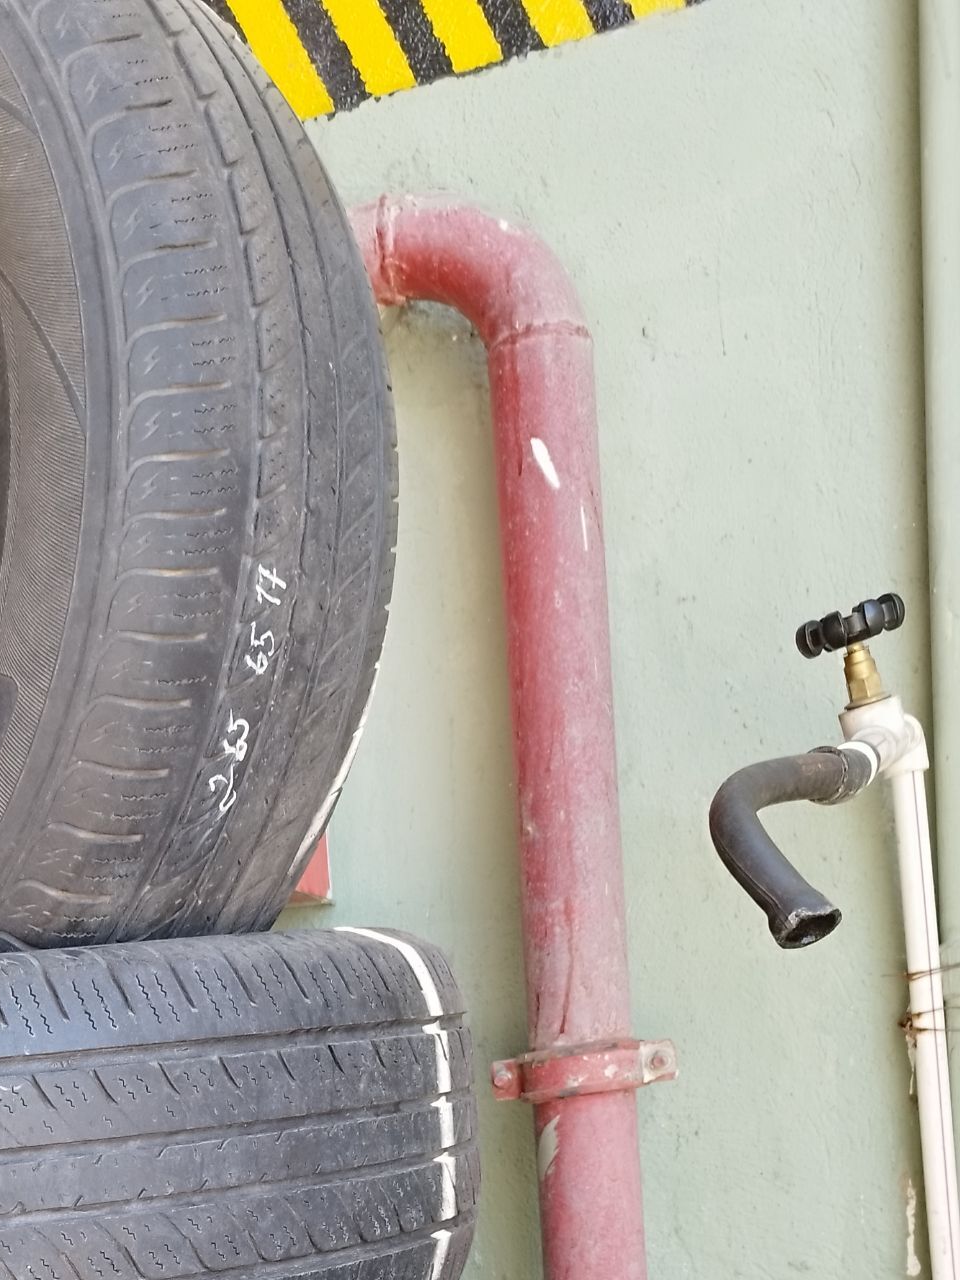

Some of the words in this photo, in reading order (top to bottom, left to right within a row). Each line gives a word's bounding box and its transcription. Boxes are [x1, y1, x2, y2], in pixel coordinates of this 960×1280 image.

[256, 563, 287, 606] 17
[245, 621, 274, 675] 65
[209, 709, 249, 812] 265
